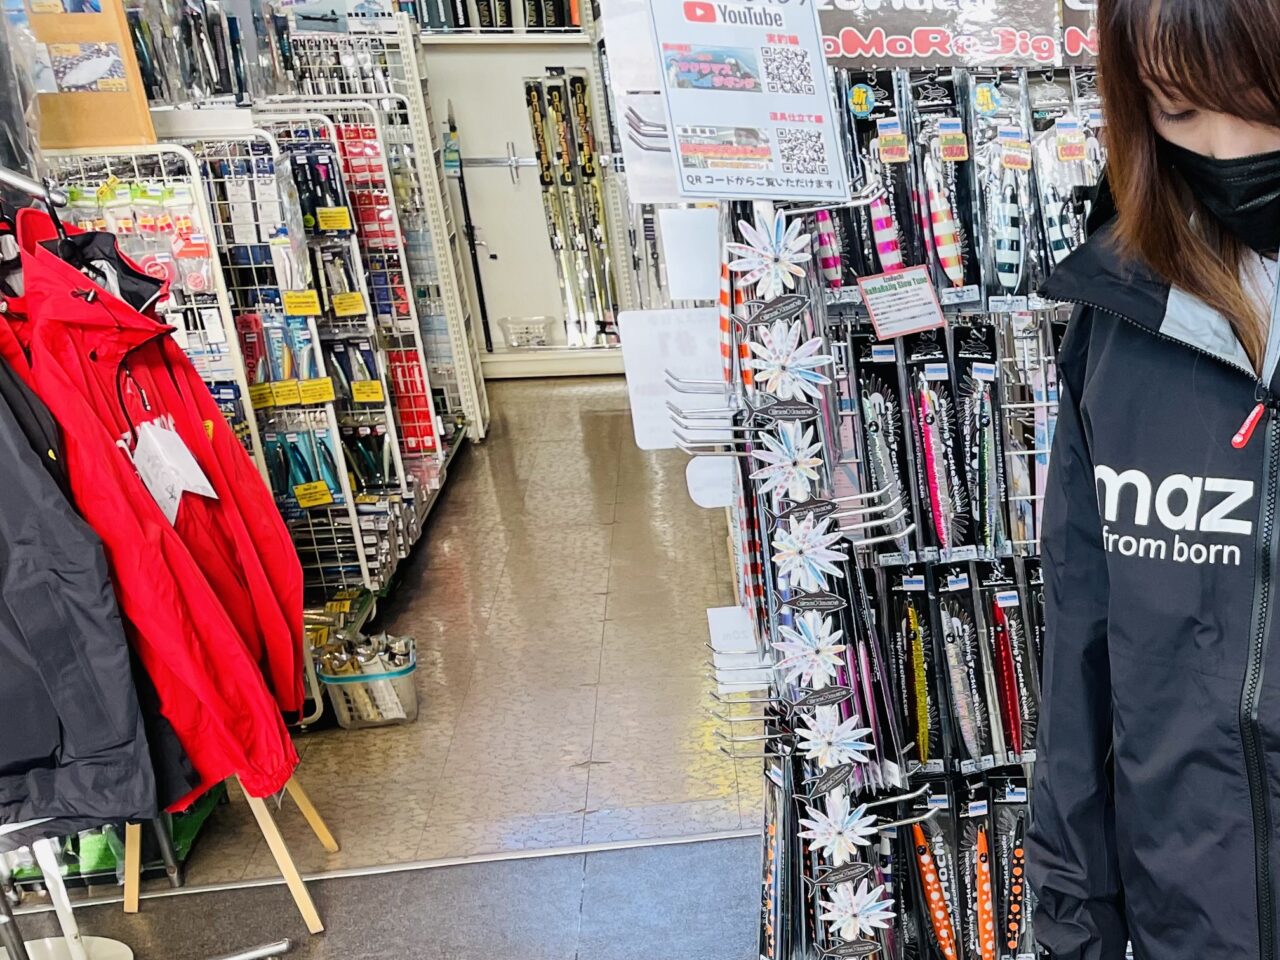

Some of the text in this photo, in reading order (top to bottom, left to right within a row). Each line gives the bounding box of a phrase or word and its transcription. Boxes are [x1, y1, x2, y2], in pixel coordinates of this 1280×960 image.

[718, 4, 783, 27] YouTube
[822, 27, 1056, 62] aMaRaJig
[1103, 526, 1168, 560] from
[1173, 533, 1241, 565] born
